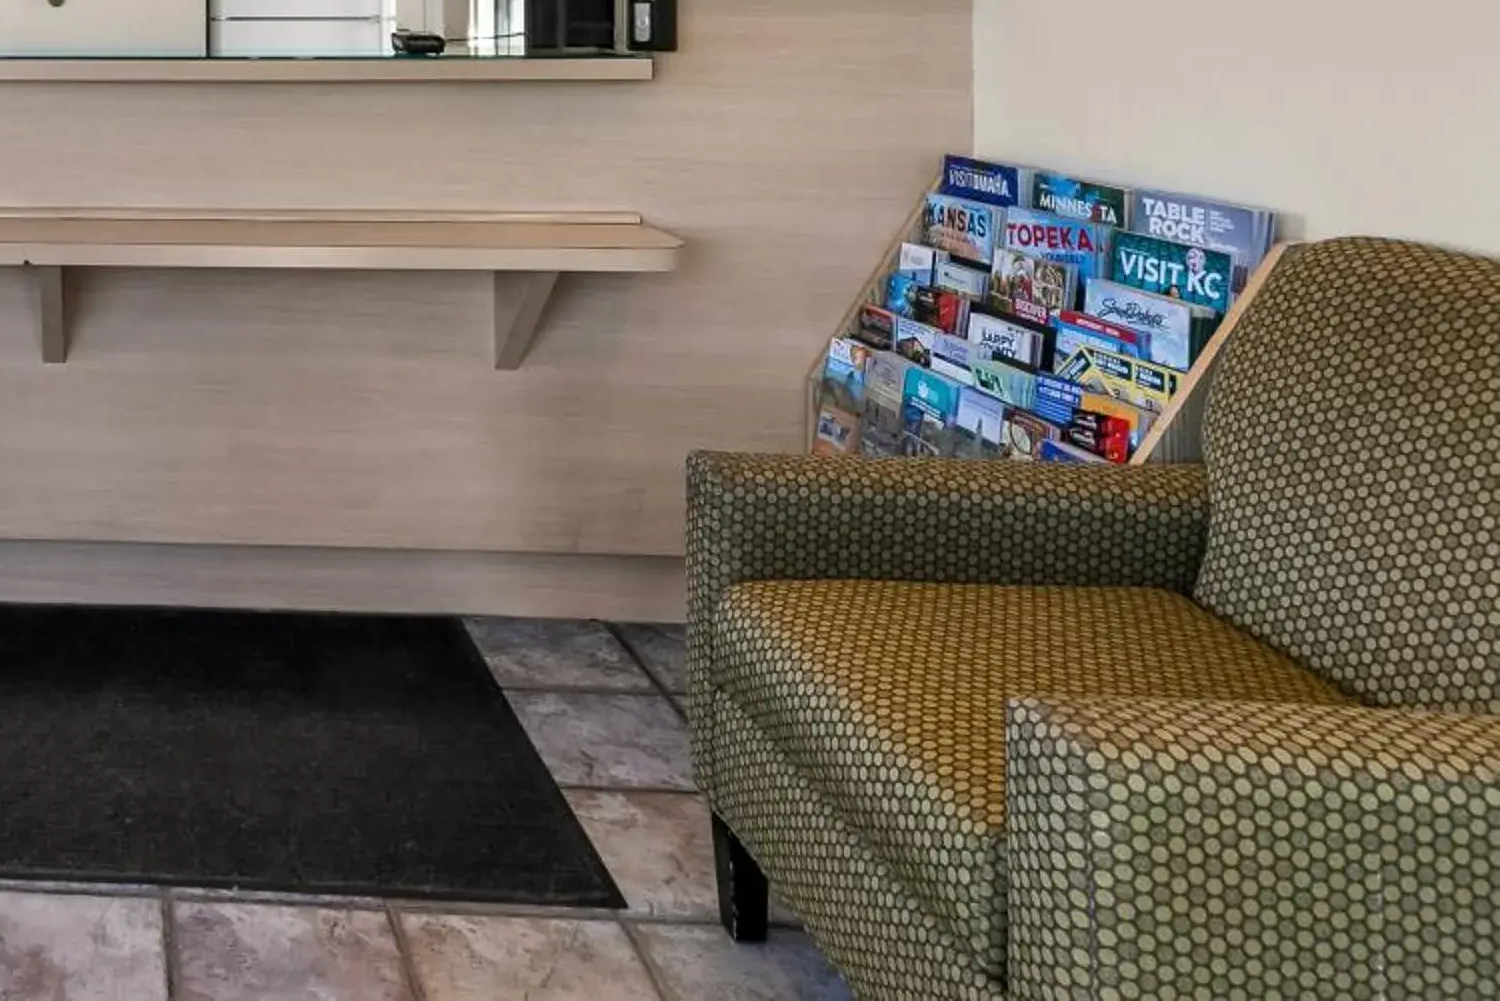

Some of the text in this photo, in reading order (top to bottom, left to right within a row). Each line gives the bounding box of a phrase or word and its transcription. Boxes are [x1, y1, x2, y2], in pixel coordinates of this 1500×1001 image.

[927, 202, 987, 238] KANSAS
[1142, 197, 1205, 226] TABLE
[1006, 222, 1094, 252] TOPEKA
[1149, 216, 1205, 244] ROCK
[1119, 249, 1223, 299] VISIT KC
